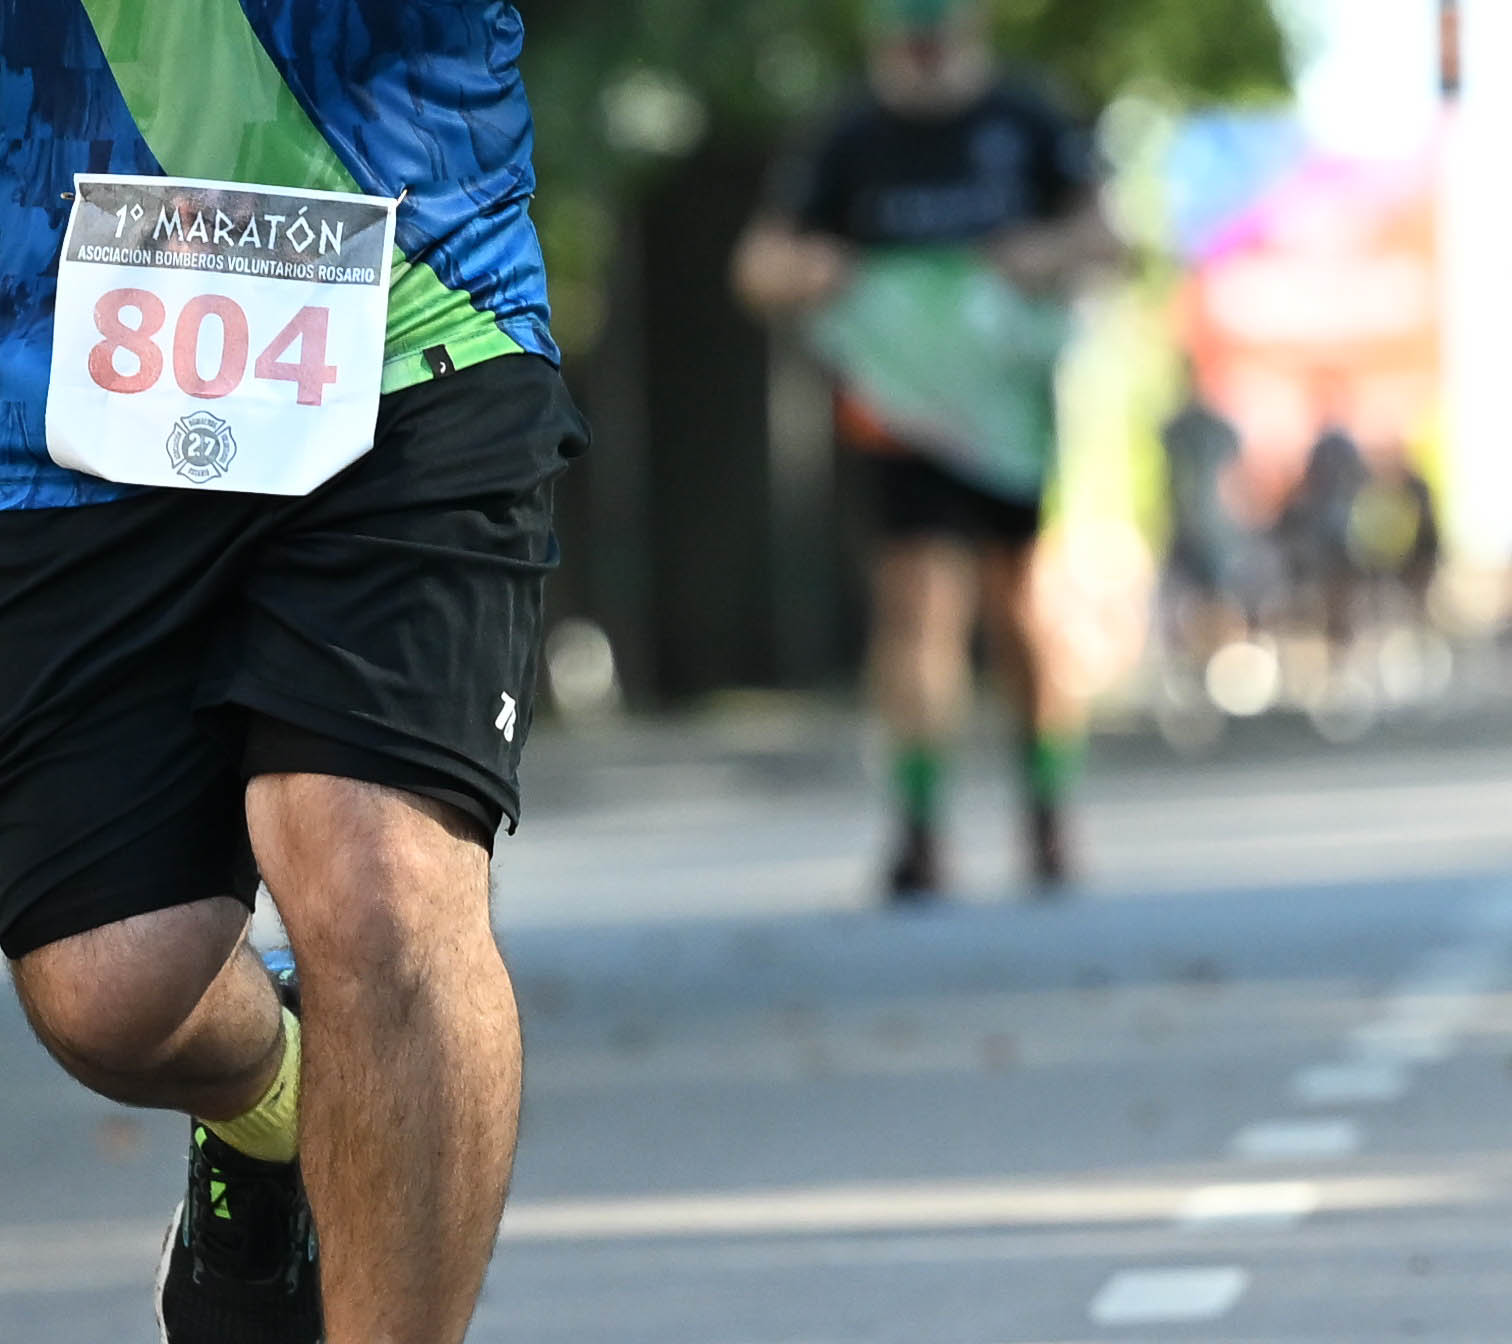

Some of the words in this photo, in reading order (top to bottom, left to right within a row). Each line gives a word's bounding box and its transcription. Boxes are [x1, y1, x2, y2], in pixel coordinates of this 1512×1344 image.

[152, 205, 344, 256] MARATÓN
[155, 251, 224, 270] BOMBEROS
[228, 256, 315, 279] VOLUNTARIOS
[318, 266, 376, 284] ROSARIO
[88, 288, 337, 406] 804
[187, 432, 216, 457] 27
